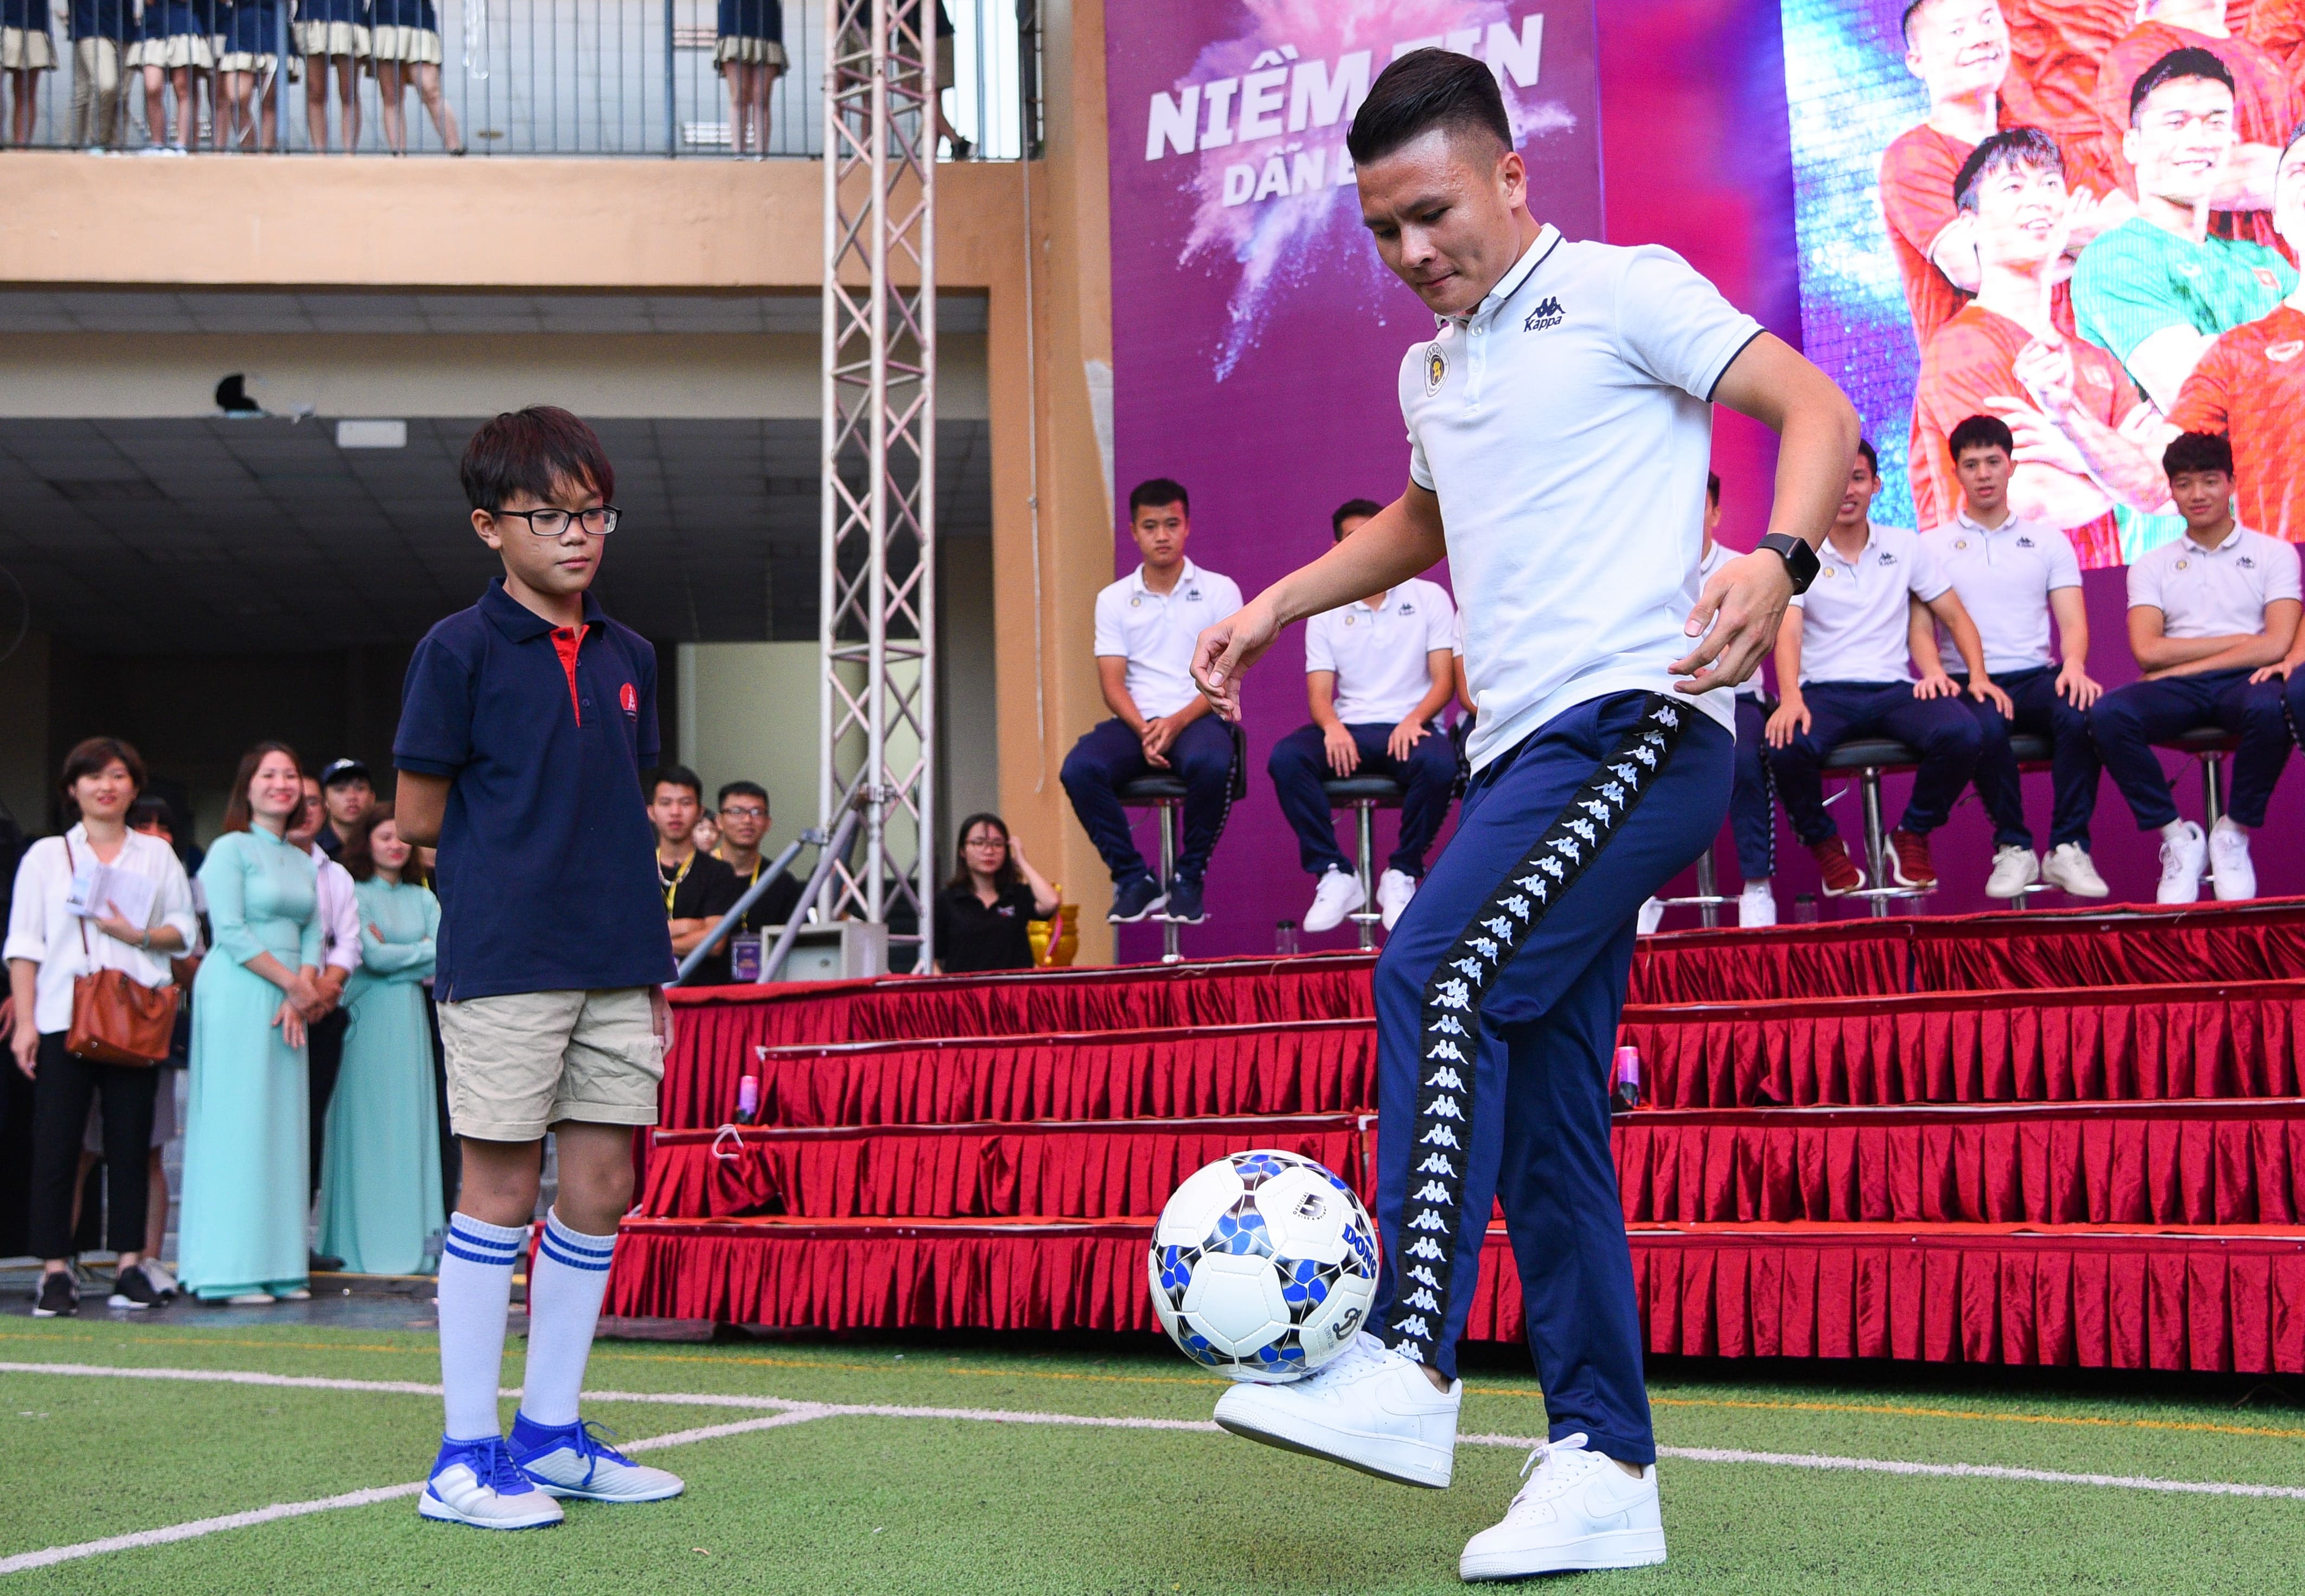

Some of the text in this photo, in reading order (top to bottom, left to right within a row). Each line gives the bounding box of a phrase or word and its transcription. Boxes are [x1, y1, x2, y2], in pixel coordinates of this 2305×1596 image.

[1145, 44, 1372, 162] NIỀM
[1222, 142, 1327, 208] DẪN
[1523, 316, 1562, 333] Kappa
[1427, 347, 1442, 365] HANOI
[1299, 1193, 1324, 1217] 5
